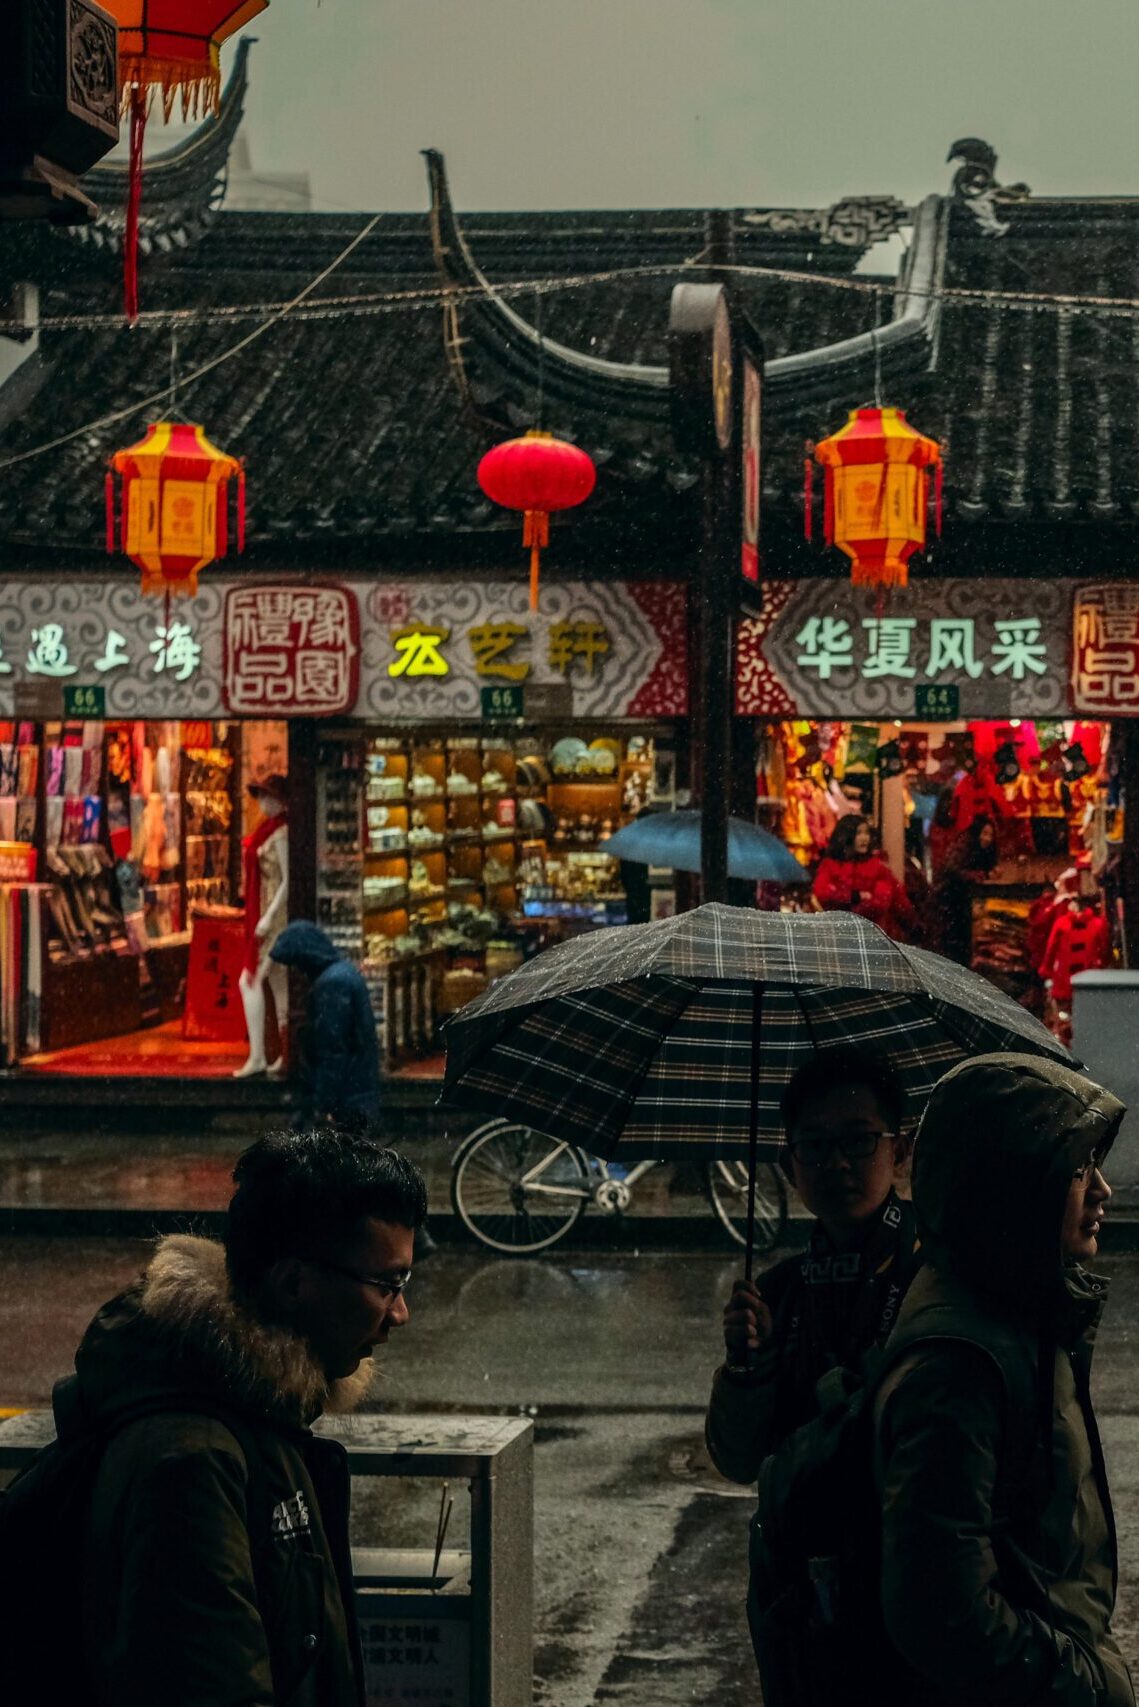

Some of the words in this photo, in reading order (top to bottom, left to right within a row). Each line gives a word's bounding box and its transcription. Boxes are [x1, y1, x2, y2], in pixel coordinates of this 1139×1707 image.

[0, 621, 201, 681] 遇上海
[795, 616, 1048, 679] 华夏风采
[74, 687, 96, 706] 66
[491, 690, 512, 706] 66
[926, 687, 949, 705] 64
